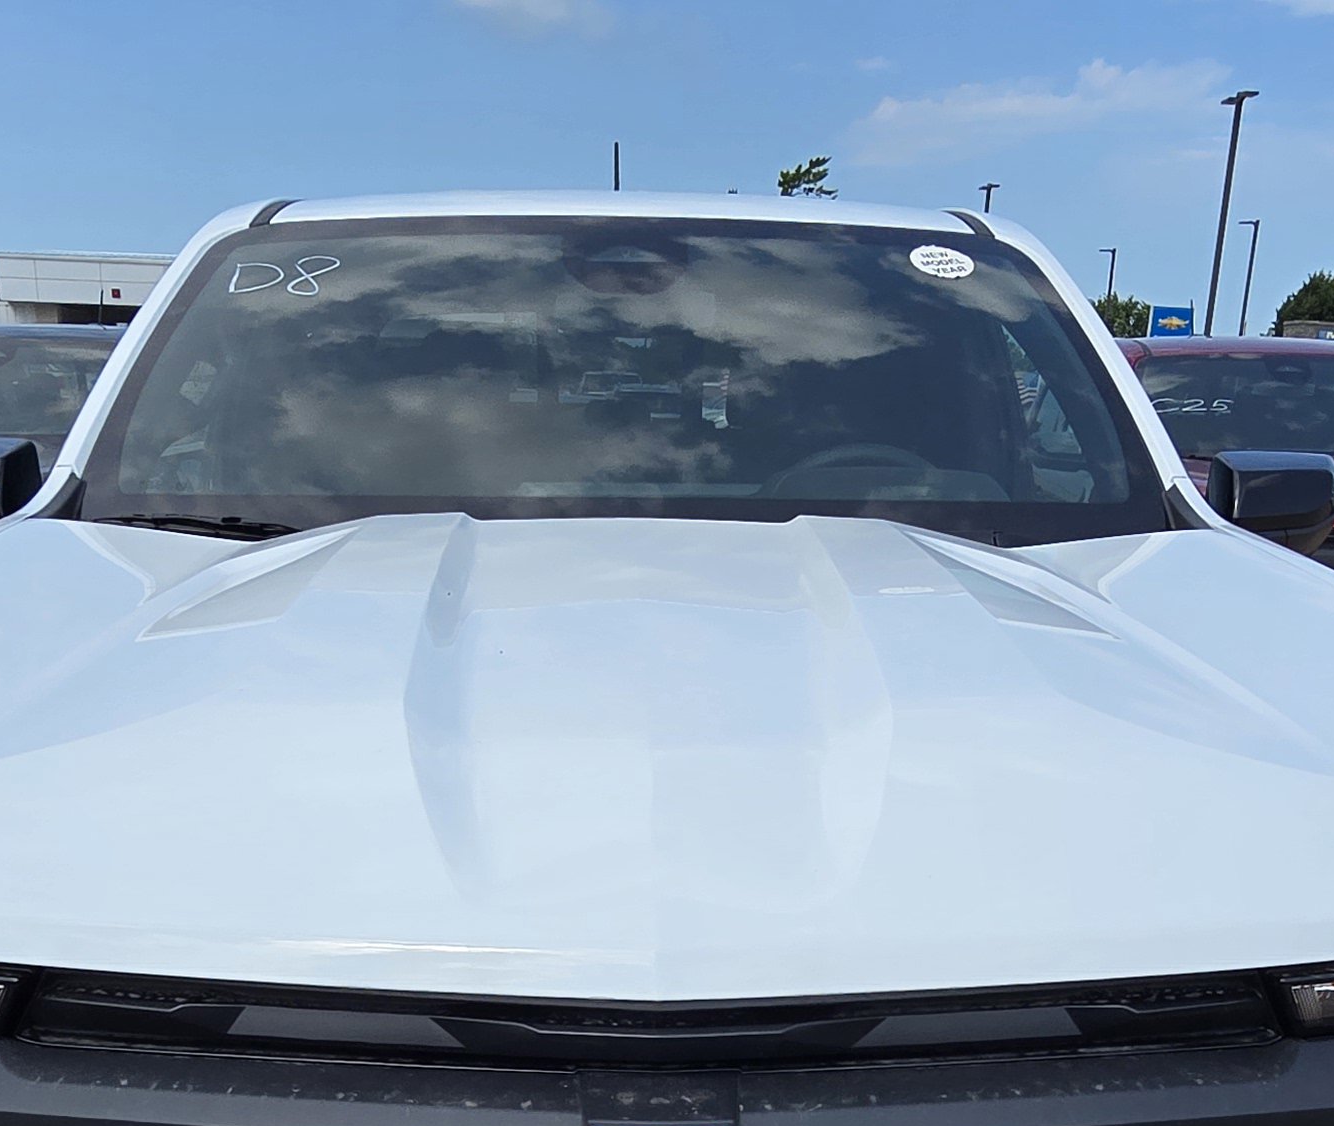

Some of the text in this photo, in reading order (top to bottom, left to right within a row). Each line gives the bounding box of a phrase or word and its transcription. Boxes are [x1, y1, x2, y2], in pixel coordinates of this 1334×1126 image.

[920, 250, 949, 259] NEW
[920, 258, 966, 267] MODEL
[932, 265, 967, 274] YEAR
[228, 255, 341, 296] D8
[1151, 398, 1234, 413] C25
